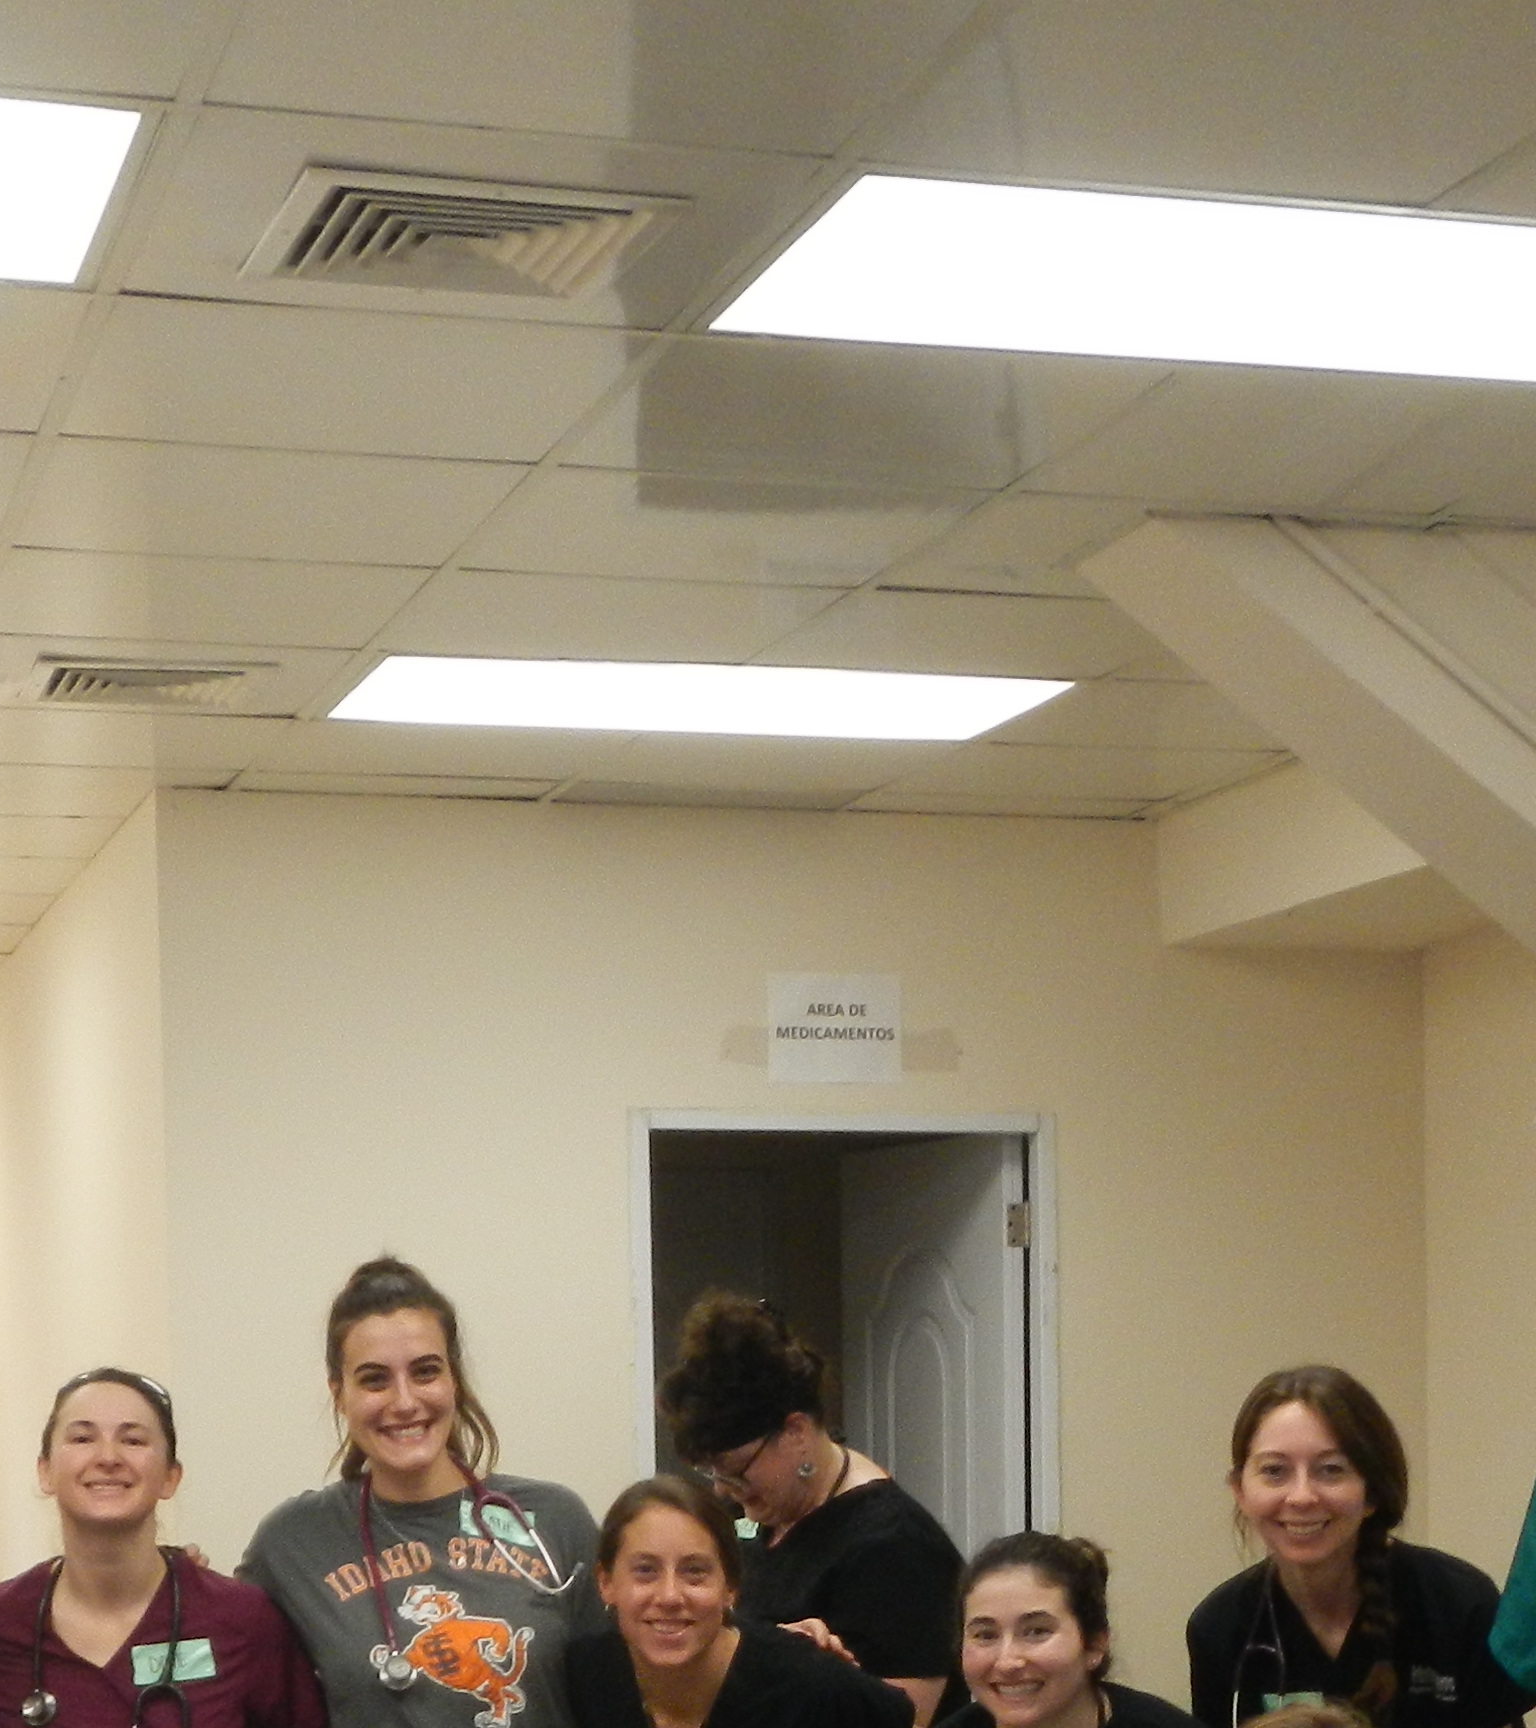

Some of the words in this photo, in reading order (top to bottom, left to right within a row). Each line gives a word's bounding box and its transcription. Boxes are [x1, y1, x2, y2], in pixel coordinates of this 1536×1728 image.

[806, 1003, 845, 1017] AREA
[849, 1003, 867, 1017] DE
[776, 1026, 895, 1041] MEDICAMENTOS
[324, 1541, 432, 1601] IDAHO
